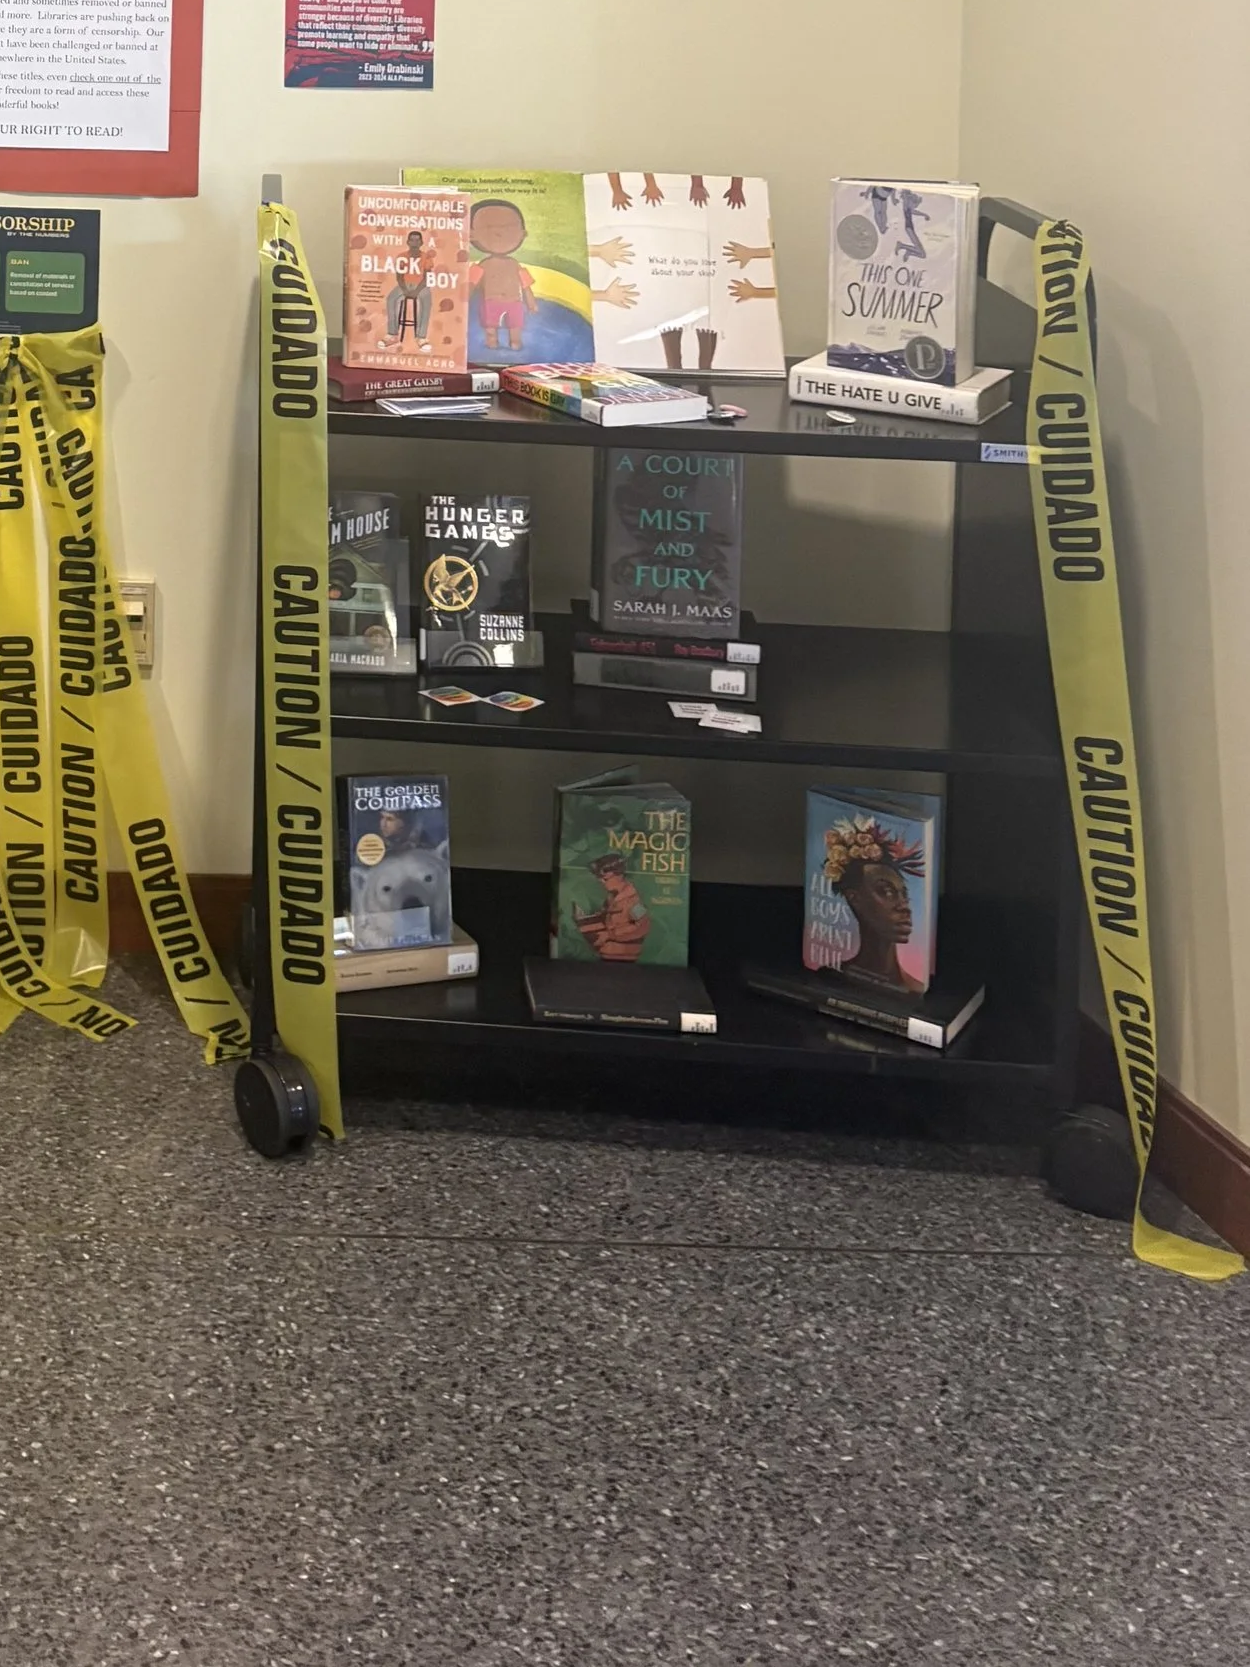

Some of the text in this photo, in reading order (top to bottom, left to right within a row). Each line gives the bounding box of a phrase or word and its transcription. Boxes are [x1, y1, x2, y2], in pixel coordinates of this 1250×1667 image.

[21, 125, 62, 135] RIGHT
[66, 126, 82, 136] TO
[86, 126, 123, 136] READ!
[359, 197, 464, 214] UNCOMFORTABLE
[358, 215, 463, 231] CONVERSATIONS
[372, 234, 435, 248] WITH A
[361, 255, 422, 275] BLACK
[860, 263, 926, 287] THIS ONE
[426, 271, 459, 289] BOY
[842, 282, 944, 328] SUMMER
[806, 380, 942, 409] THE HATE U GIVE
[616, 455, 731, 477] A COURT
[663, 484, 688, 500] OF
[1036, 393, 1105, 582] CUIDADO
[431, 496, 456, 506] THE
[425, 507, 524, 524] HUNGER
[639, 509, 712, 533] MIST
[425, 524, 514, 547] GAMES
[654, 541, 694, 558] AND
[634, 566, 713, 591] FURY
[480, 614, 524, 628] SUZANNE
[480, 628, 525, 642] COLLINS
[60, 706, 95, 733] /
[273, 565, 326, 986] CAUTION / CUIDADO
[355, 783, 440, 798] THE GOLDEN
[355, 794, 442, 811] COMPASS
[60, 742, 99, 903] CAUTION
[644, 811, 687, 831] THE
[608, 830, 688, 852] MAGIC
[1074, 735, 1140, 938] CAUTION
[642, 852, 686, 872] FISH
[128, 817, 211, 983] CUIDADO
